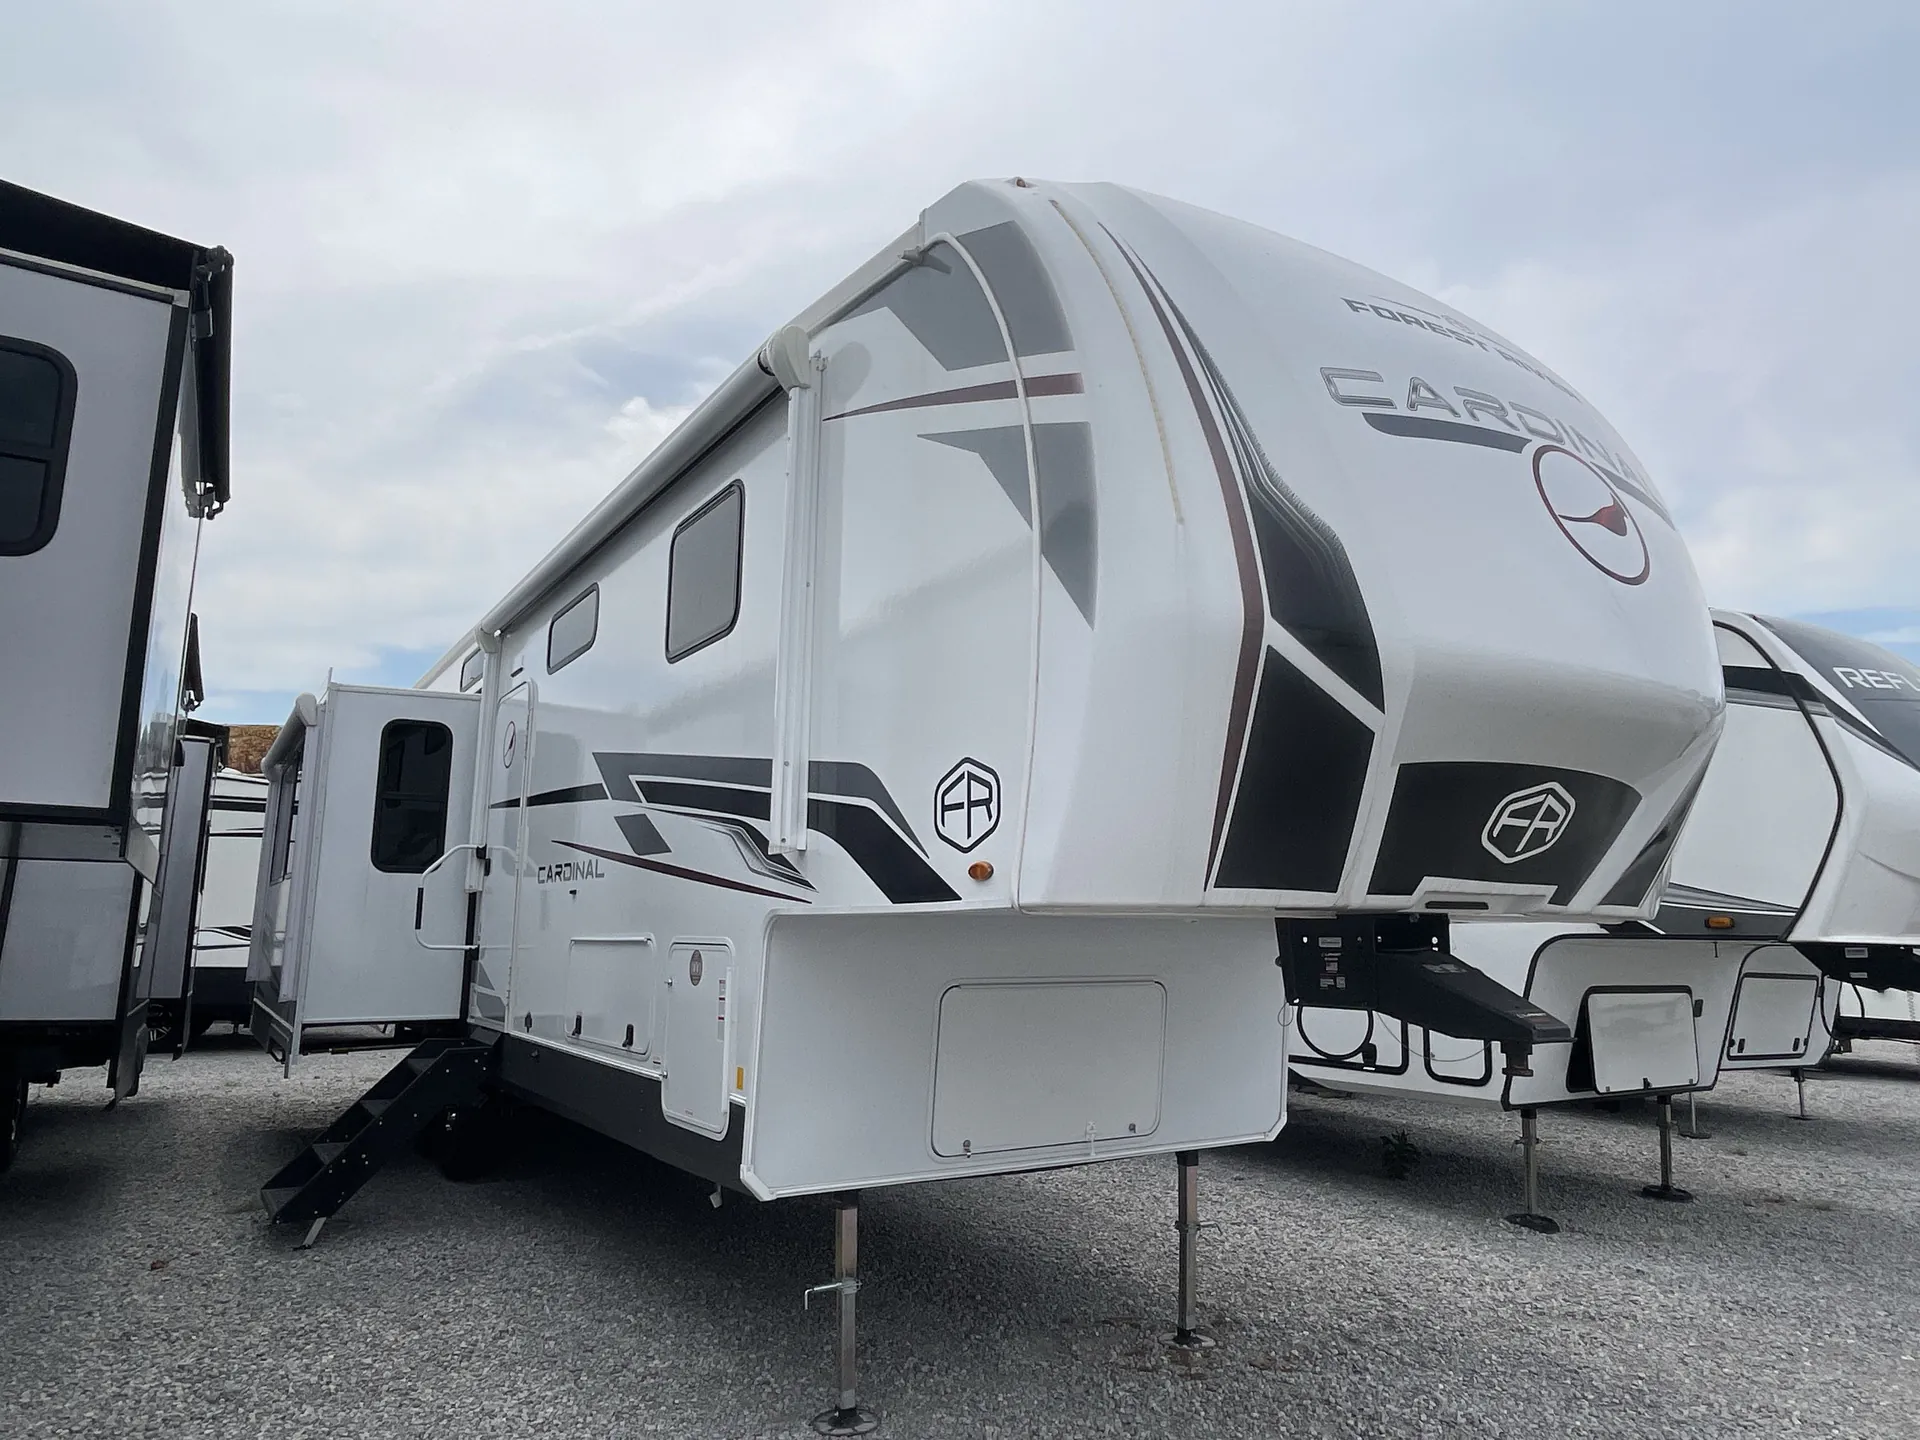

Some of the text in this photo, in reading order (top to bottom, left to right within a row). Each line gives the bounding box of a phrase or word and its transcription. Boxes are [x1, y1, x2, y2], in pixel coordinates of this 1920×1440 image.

[1340, 296, 1489, 353] FOREST
[1833, 667, 1920, 692] REFL
[537, 859, 605, 884] CARDINAL
